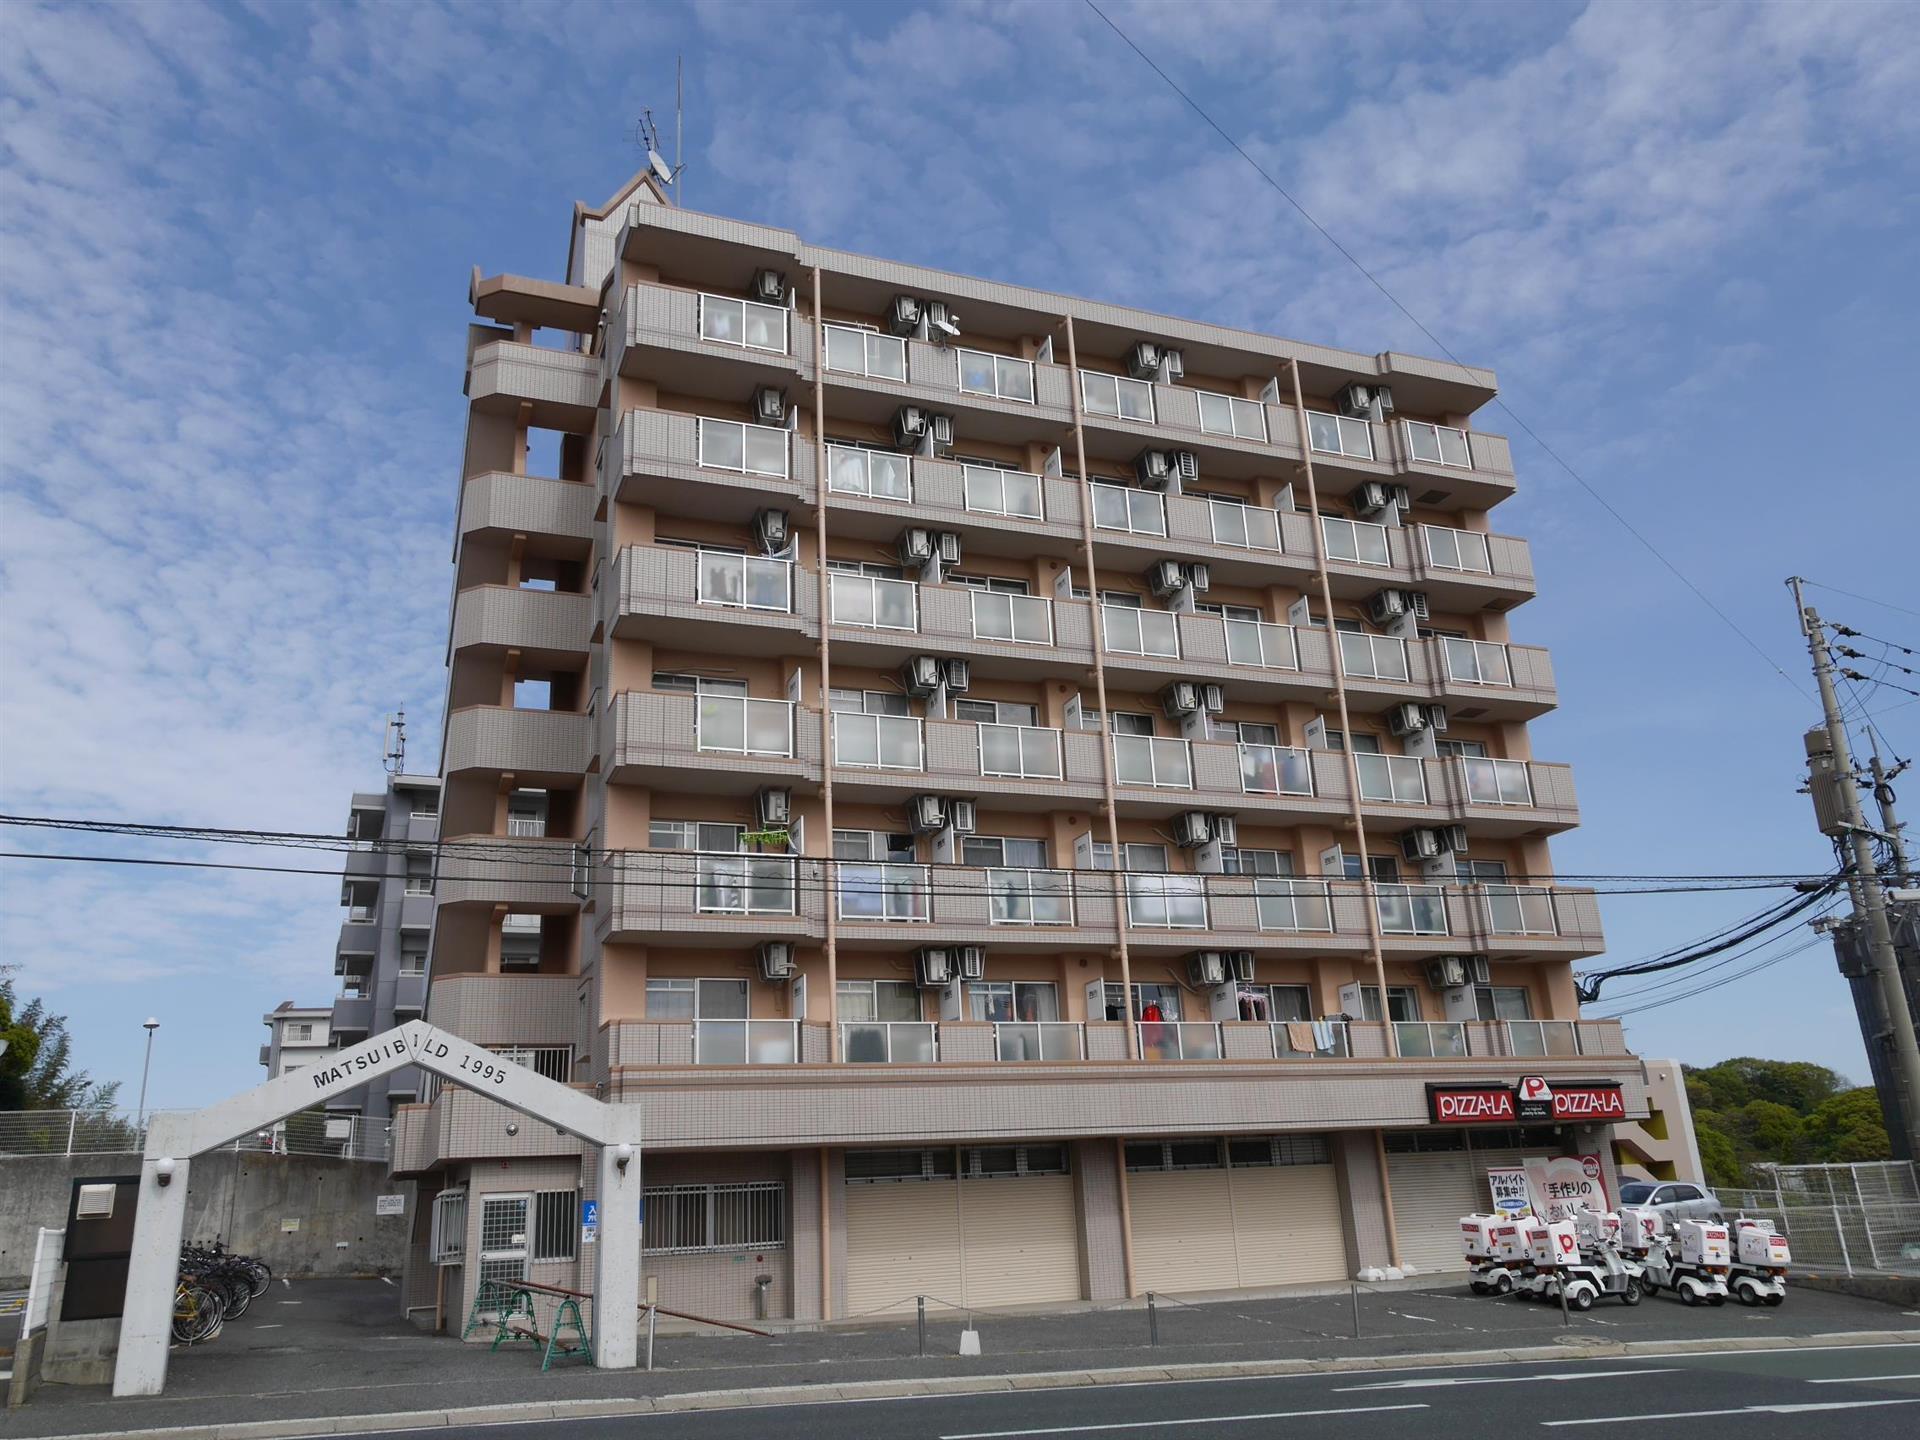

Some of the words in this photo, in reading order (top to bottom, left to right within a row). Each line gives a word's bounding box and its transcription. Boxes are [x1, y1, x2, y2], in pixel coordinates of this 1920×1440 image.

[459, 1055, 507, 1084] 1995
[1440, 1095, 1512, 1117] PIZZA-LA
[1554, 1093, 1622, 1113] PIZZA-LA
[1490, 1174, 1525, 1186] アルバイト
[1556, 1252, 1563, 1263] 2
[1764, 1248, 1768, 1257] 1
[1697, 1254, 1704, 1264] 6
